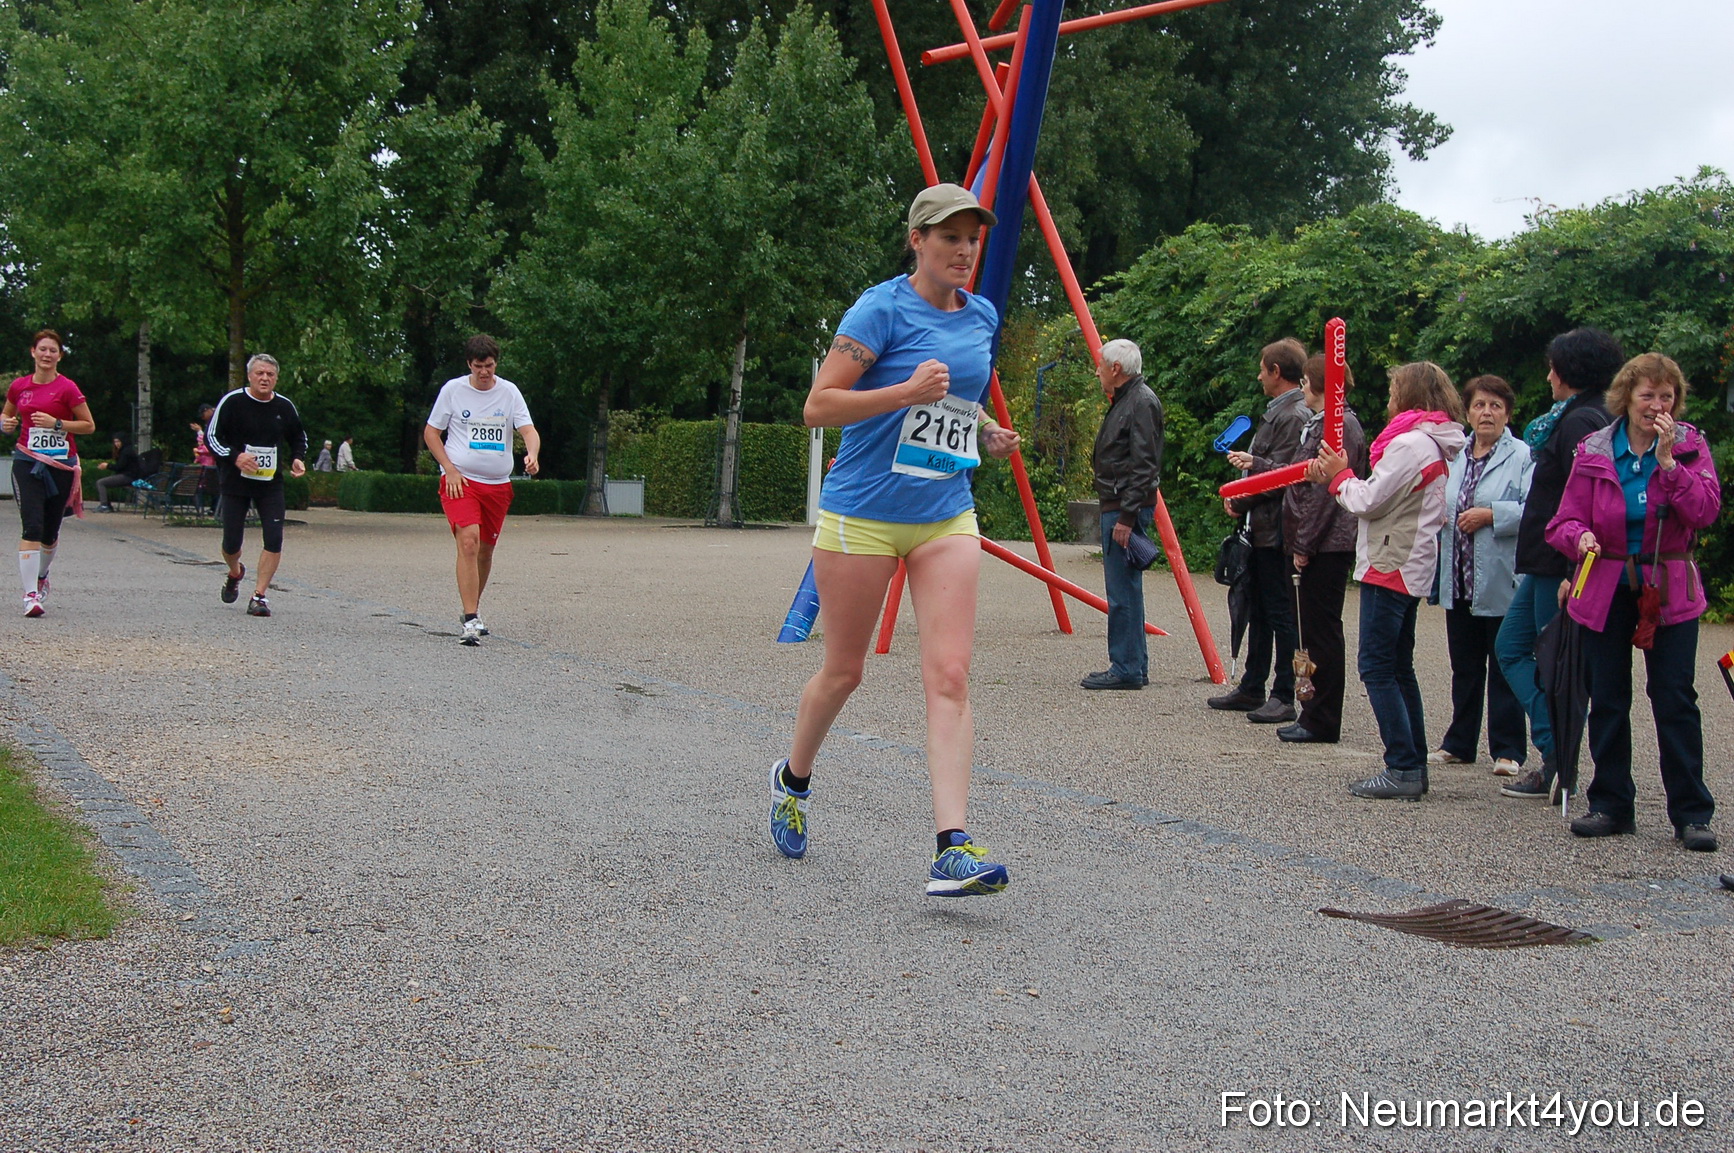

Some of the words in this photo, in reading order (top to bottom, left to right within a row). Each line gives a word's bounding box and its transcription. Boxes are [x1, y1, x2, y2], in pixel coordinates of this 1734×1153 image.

[1334, 382, 1345, 417] BKK
[471, 427, 503, 441] 2880
[910, 409, 972, 453] 2161
[32, 434, 65, 448] 2605
[926, 453, 956, 472] Katja
